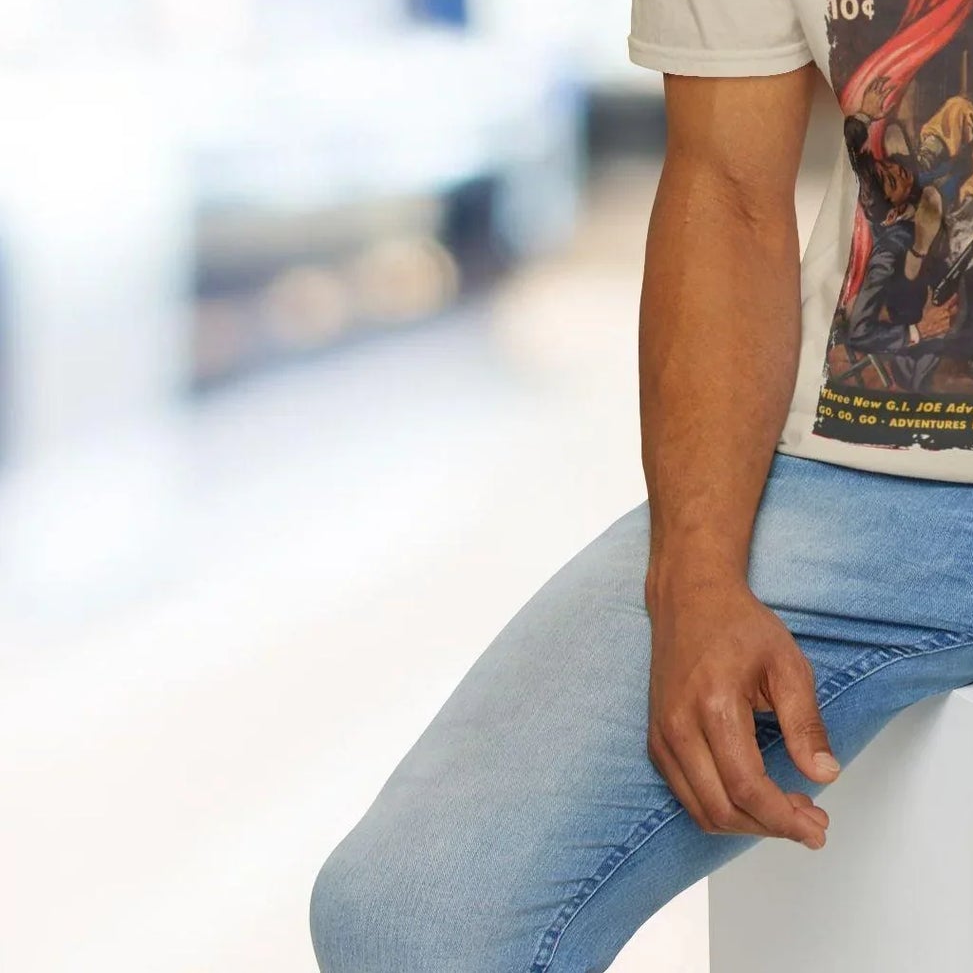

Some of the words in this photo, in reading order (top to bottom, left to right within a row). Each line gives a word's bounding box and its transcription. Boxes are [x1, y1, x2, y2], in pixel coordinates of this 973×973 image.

[821, 388, 850, 405] Three
[853, 395, 882, 409] New
[916, 402, 943, 413] JOE
[818, 405, 834, 418] GO,
[838, 410, 855, 424] GO,
[859, 414, 877, 425] GO
[889, 418, 966, 431] ADVENTURES
